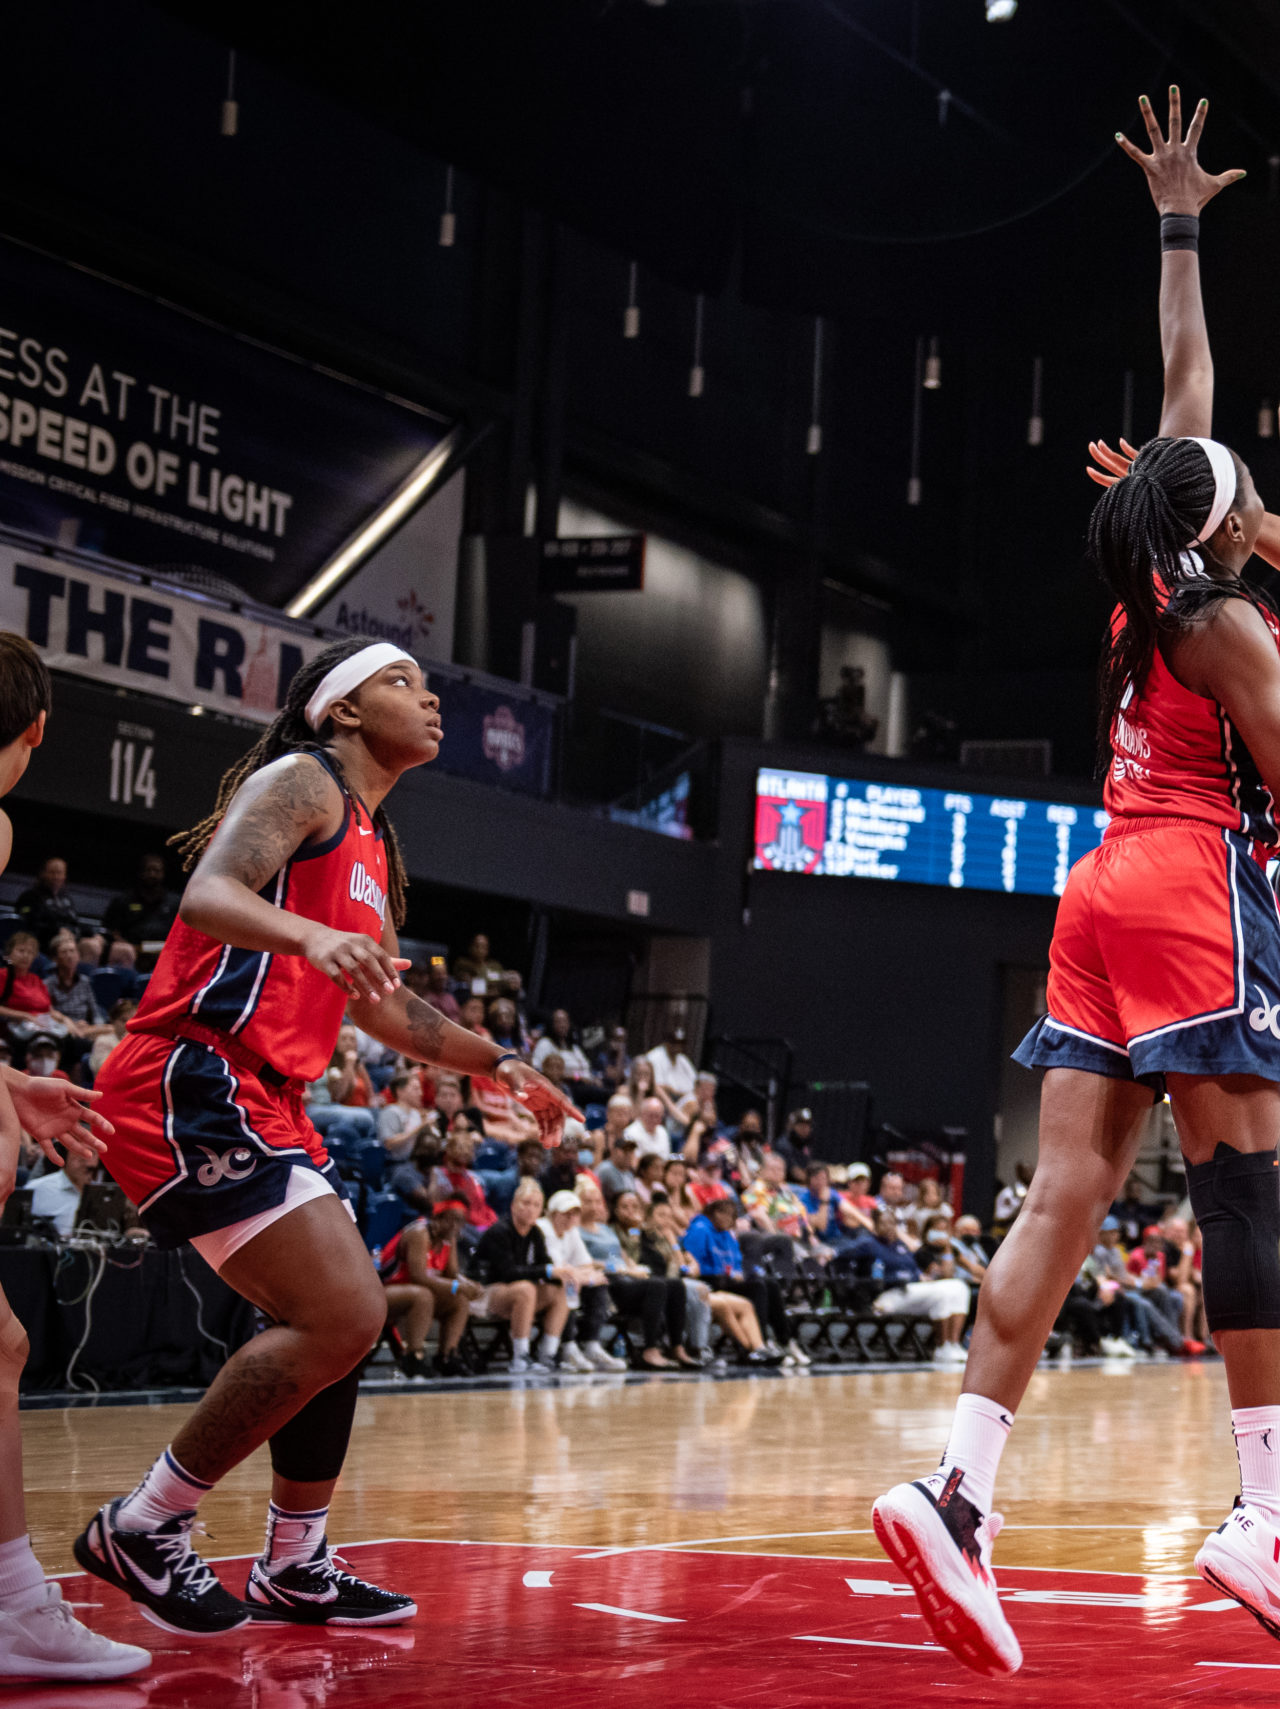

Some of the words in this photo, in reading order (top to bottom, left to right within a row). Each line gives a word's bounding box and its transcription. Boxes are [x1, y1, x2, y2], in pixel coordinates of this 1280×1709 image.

[79, 362, 136, 421] AT
[147, 384, 221, 455] THE
[126, 441, 180, 496] OF
[187, 460, 292, 537] LIGHT
[14, 562, 174, 682] THE
[109, 739, 156, 809] 114
[757, 774, 828, 803] ATLANTA
[866, 785, 921, 807] PLAYER
[944, 793, 973, 814] PTS
